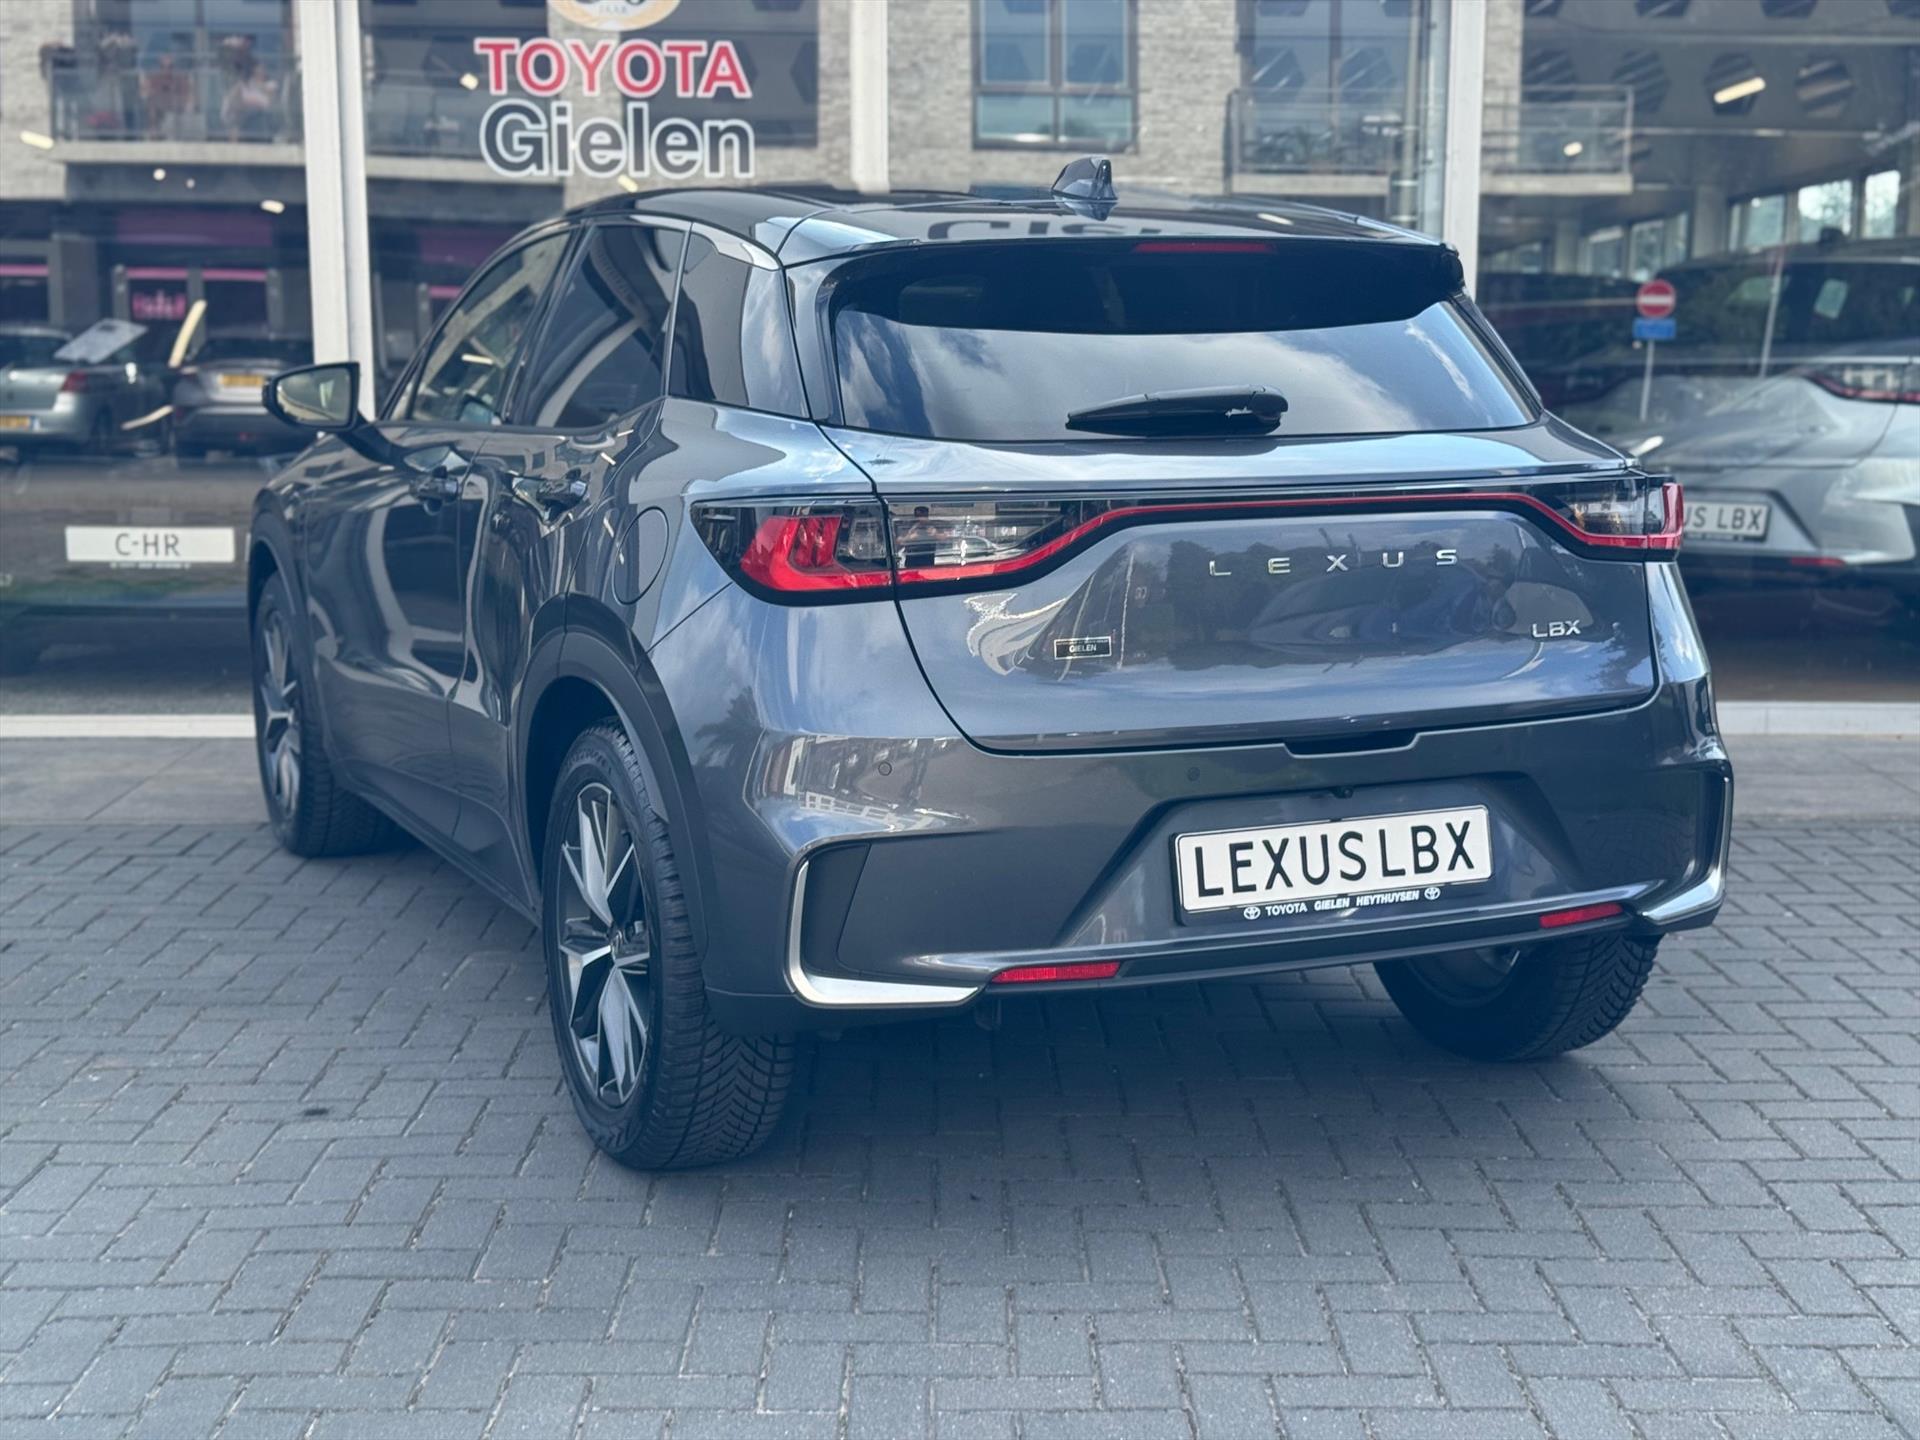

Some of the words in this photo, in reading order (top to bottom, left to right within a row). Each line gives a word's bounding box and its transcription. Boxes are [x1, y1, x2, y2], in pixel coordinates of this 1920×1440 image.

[474, 37, 752, 98] TOYOTA
[479, 98, 755, 179] Gielen
[1717, 507, 1763, 532] LBX
[114, 532, 181, 557] C-HR
[1209, 548, 1458, 577] LEXUS
[1532, 619, 1582, 639] LBX
[1265, 904, 1308, 916] TOYOTA
[1314, 897, 1350, 912] GIELEN
[1356, 889, 1420, 907] HEYTHUYSEN
